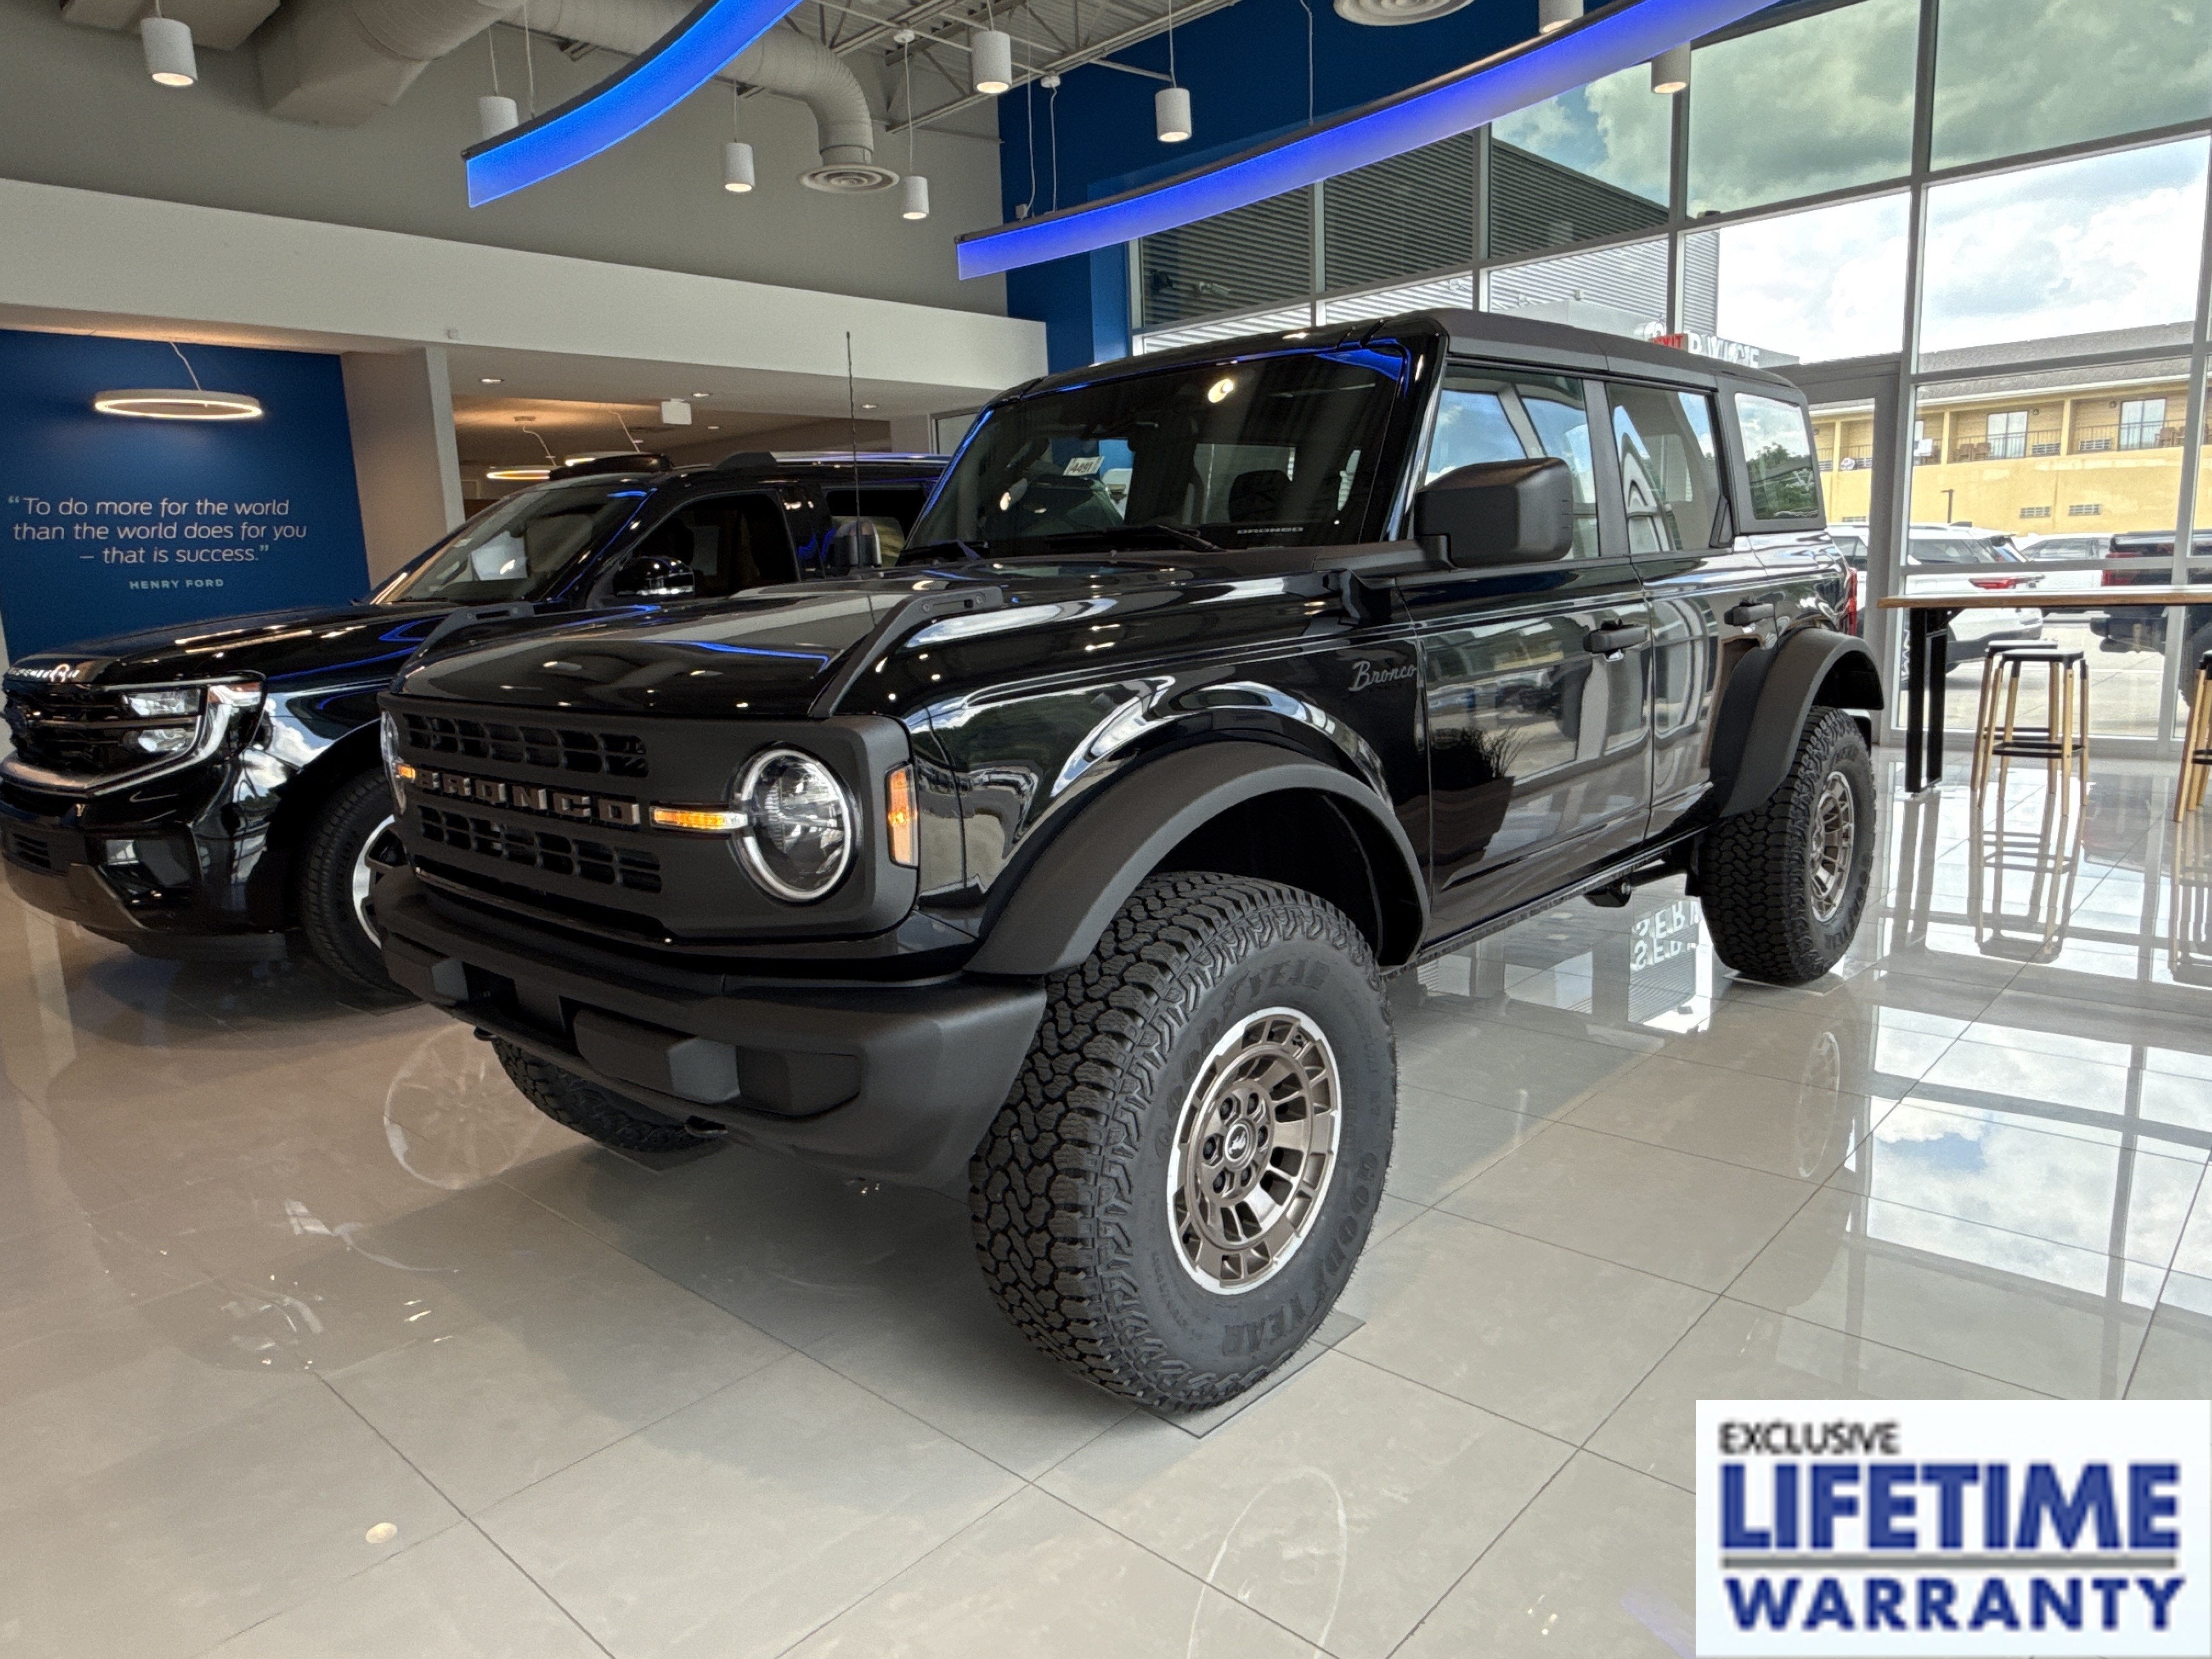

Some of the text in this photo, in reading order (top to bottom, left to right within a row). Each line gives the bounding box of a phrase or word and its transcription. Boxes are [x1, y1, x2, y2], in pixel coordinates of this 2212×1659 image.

[58, 497, 88, 516] do
[95, 501, 153, 516] more
[160, 497, 189, 518] for
[195, 498, 228, 516] the
[234, 499, 290, 516] world
[13, 522, 307, 541] than the world does for you
[102, 546, 146, 564] that
[153, 546, 169, 563] is
[129, 578, 224, 590] HENRY FORD
[1347, 660, 1417, 691] Bronco
[414, 768, 642, 825] BRONCO
